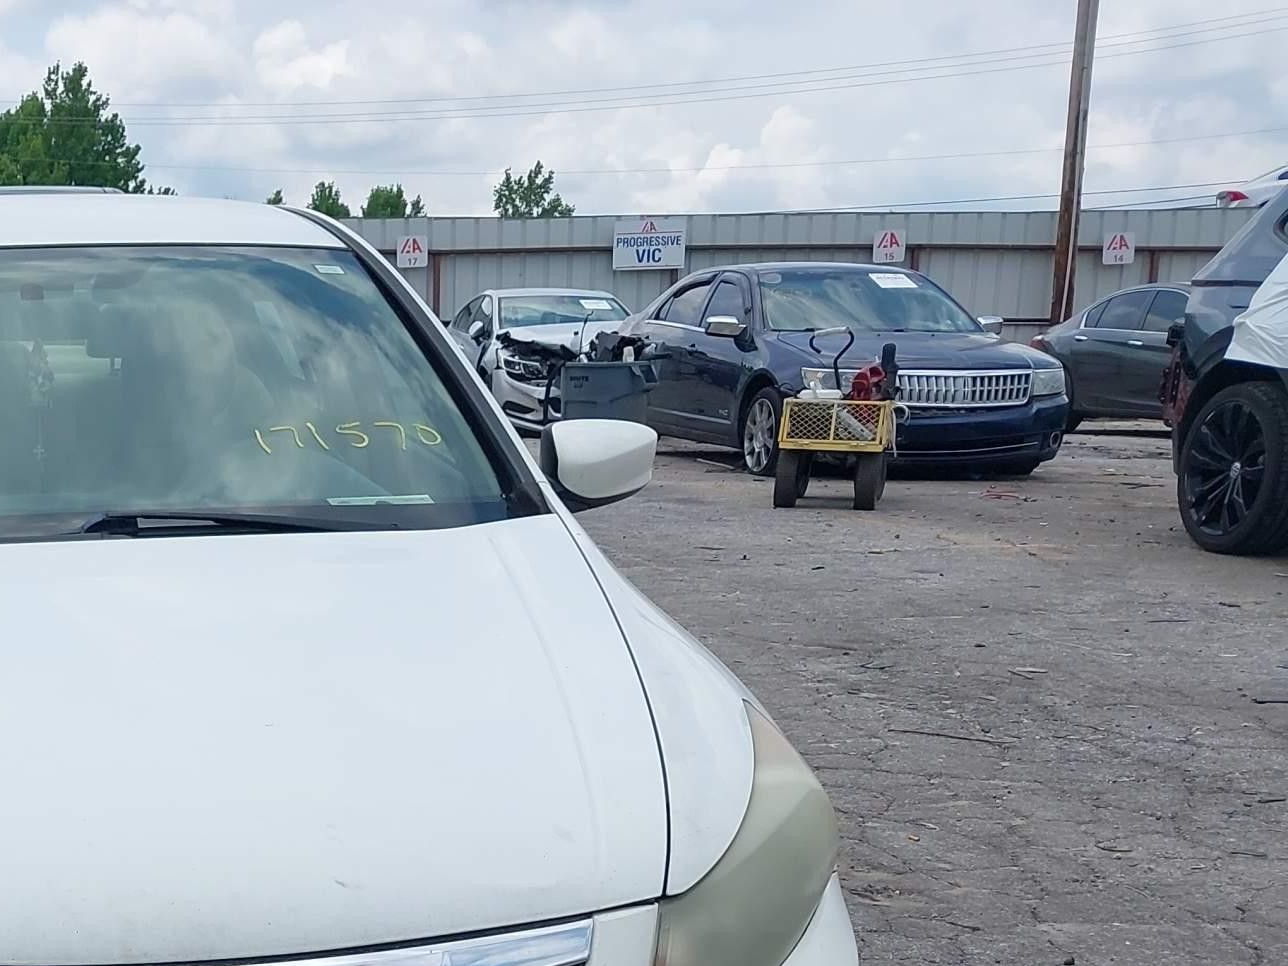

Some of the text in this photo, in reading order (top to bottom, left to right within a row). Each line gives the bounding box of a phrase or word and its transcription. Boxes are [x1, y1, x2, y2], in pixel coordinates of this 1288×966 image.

[616, 235, 682, 248] PROGRESSIVE
[636, 248, 662, 263] VIC
[885, 252, 895, 261] 15
[1114, 254, 1124, 263] 14
[407, 257, 418, 266] 17
[254, 421, 442, 455] 171570
